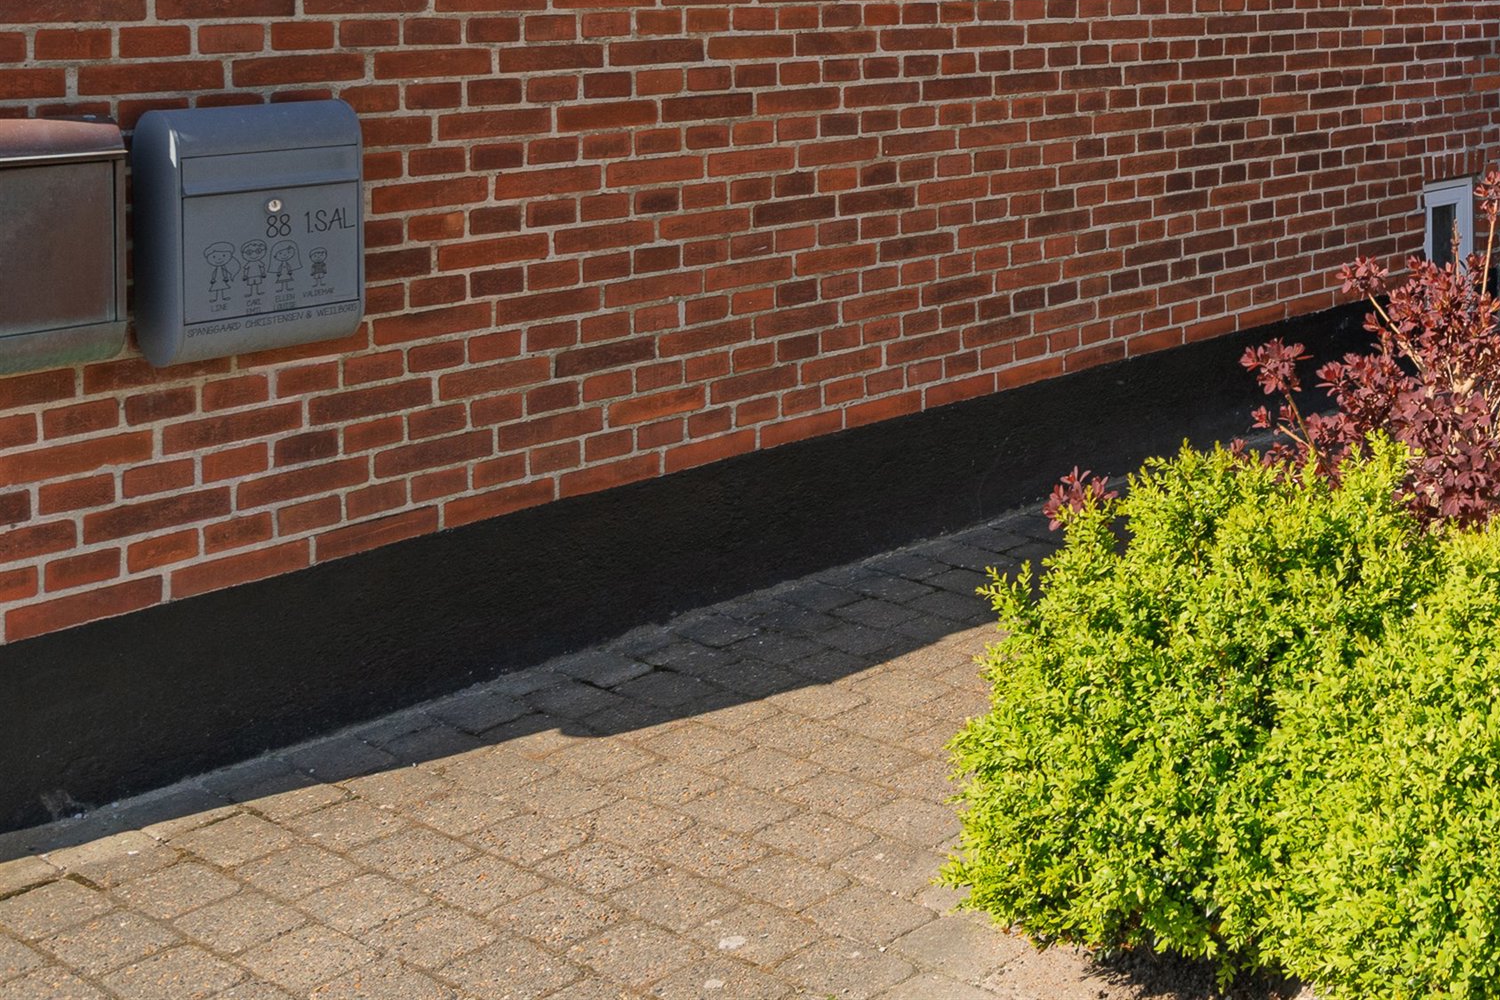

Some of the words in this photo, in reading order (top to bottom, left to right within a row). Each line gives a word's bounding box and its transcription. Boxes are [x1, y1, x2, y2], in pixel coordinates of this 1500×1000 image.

[266, 213, 292, 238] 88
[275, 293, 296, 303] ELLEN
[210, 303, 228, 312] LINE
[245, 310, 304, 329] CHRISTENSEN
[306, 309, 313, 319] &
